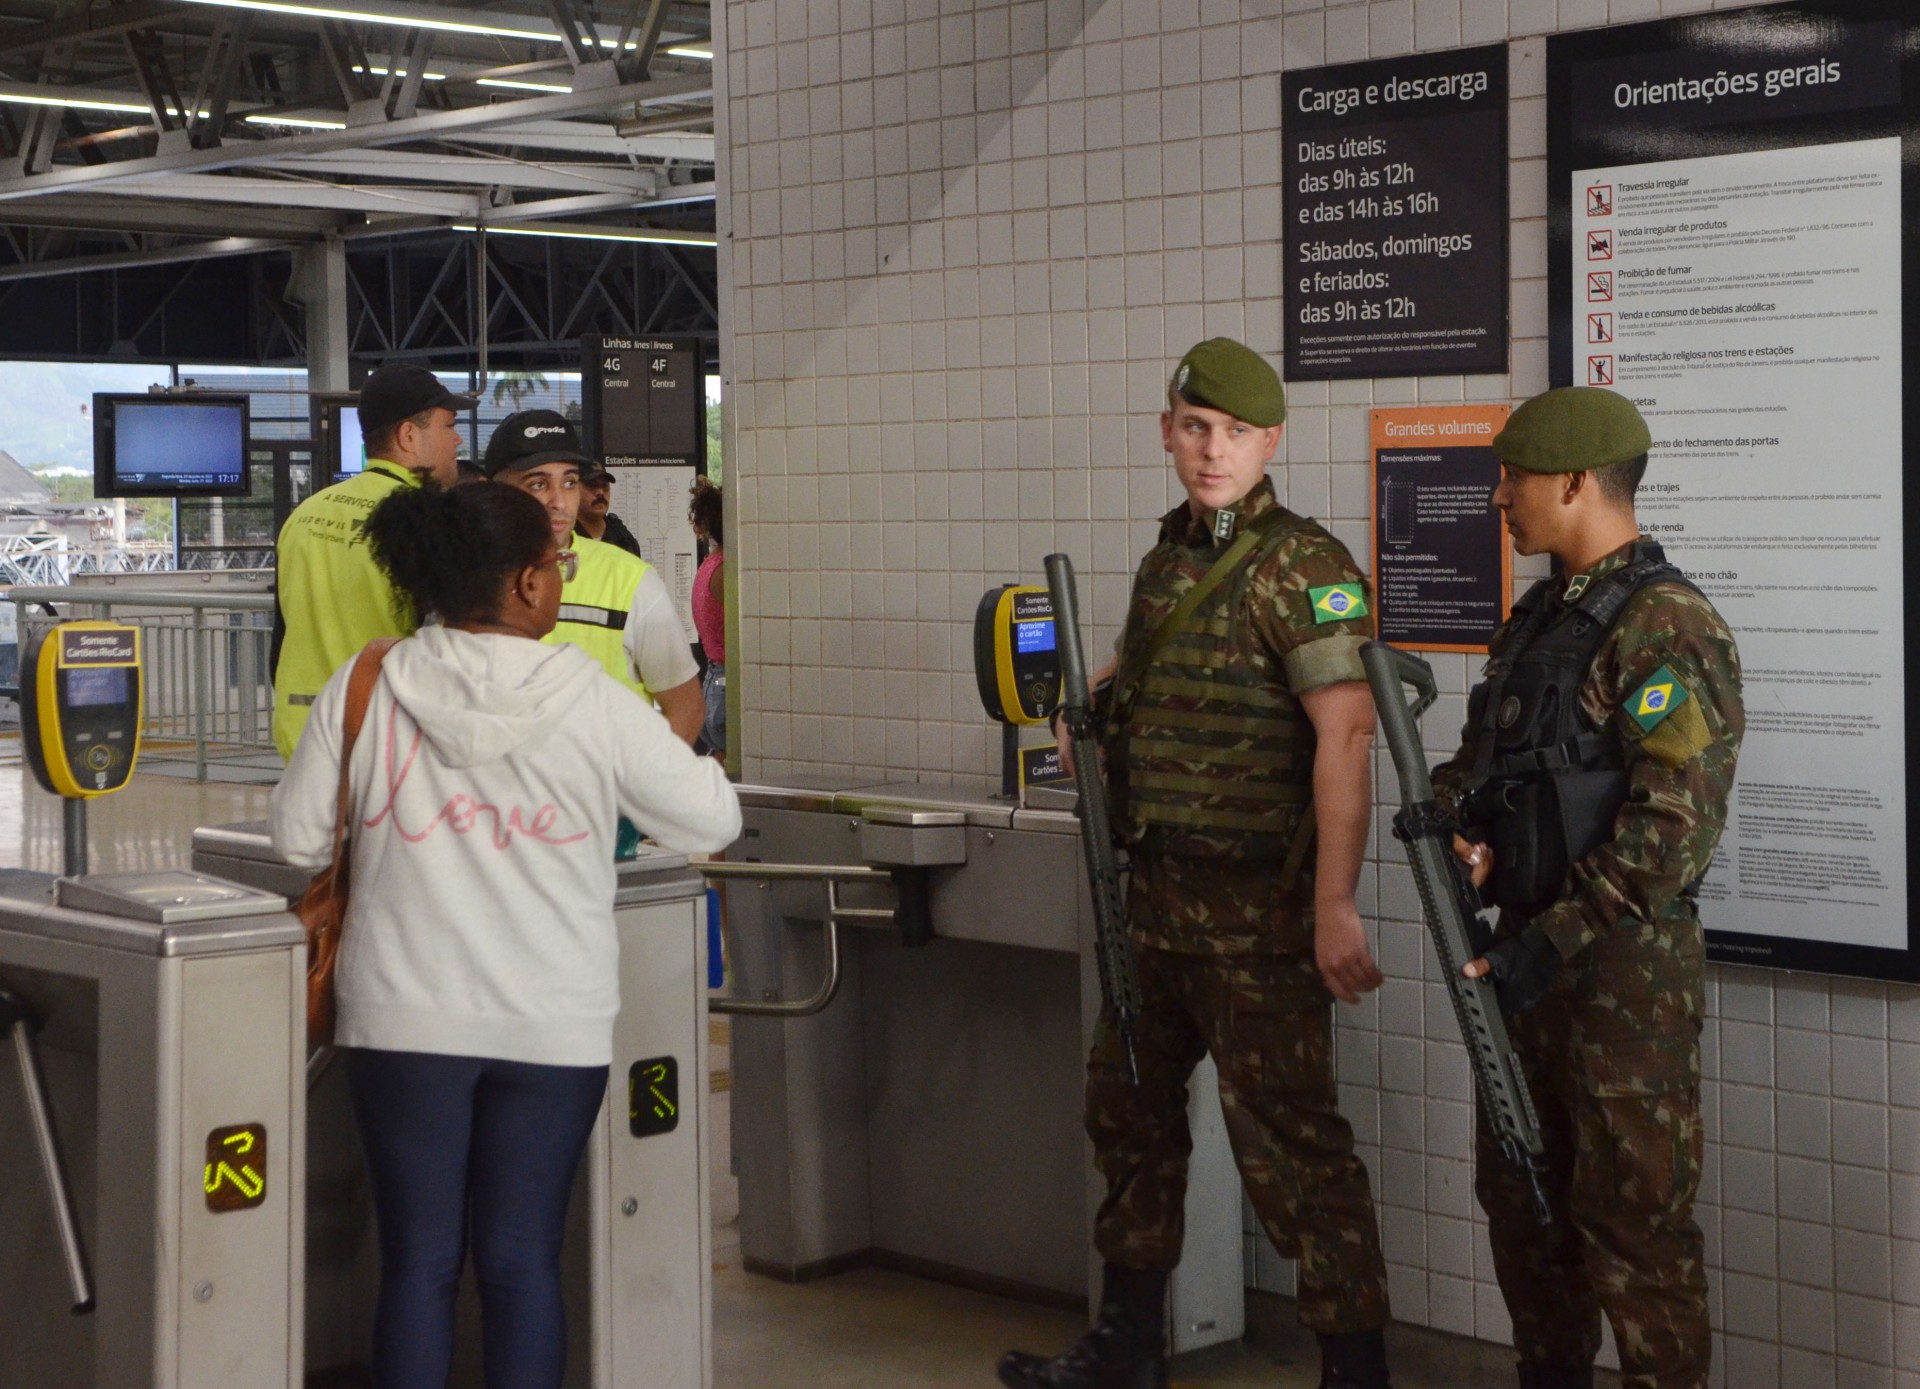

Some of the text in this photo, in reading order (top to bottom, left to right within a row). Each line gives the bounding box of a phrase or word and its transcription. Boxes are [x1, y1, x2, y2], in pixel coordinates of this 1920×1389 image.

[1615, 58, 1840, 107] Orientações gerais
[1299, 72, 1487, 115] Carga e descarga
[1299, 136, 1386, 162] Dias úteis:
[1299, 163, 1413, 193] das 9h às 12h
[1618, 178, 1689, 192] Travessia irregular
[1299, 192, 1438, 223] e das 14h às 16h
[1618, 221, 1727, 237] Venda irregular de produtos
[1300, 233, 1472, 262] Sábados, domingos
[1619, 266, 1692, 278] Proibição de fumar
[1300, 270, 1389, 293] e feriados:
[1300, 297, 1415, 323] das 9h às 12h
[1619, 311, 1643, 320] Venda
[1651, 309, 1688, 318] consumo
[1690, 307, 1699, 315] de
[1701, 305, 1733, 315] bebidas
[603, 338, 631, 349] Linhas
[1619, 352, 1671, 362] Manifestação
[1673, 351, 1707, 361] religiosa
[1708, 351, 1723, 361] nos
[1755, 346, 1794, 356] estações
[604, 358, 620, 371] 4G
[652, 359, 667, 372] 4F
[604, 379, 629, 387] Central
[652, 379, 675, 388] Central
[1385, 420, 1491, 436] Grandes volumes
[1673, 439, 1683, 447] do
[1685, 439, 1733, 447] fechamento
[1735, 437, 1750, 446] das
[1752, 437, 1779, 447] portas
[605, 456, 636, 467] Estações
[218, 474, 239, 483] 17:17
[1657, 483, 1679, 493] trajes
[1662, 523, 1684, 531] renda
[1405, 554, 1438, 562] permitidos:
[1717, 571, 1737, 579] chão
[1025, 597, 1049, 605] Somente
[1017, 606, 1037, 615] Cartões
[1019, 622, 1046, 631] Aproxime
[1024, 630, 1043, 638] cartão
[80, 635, 119, 646] Somente
[66, 648, 98, 658] Cartões
[1032, 765, 1058, 776] Cartões
